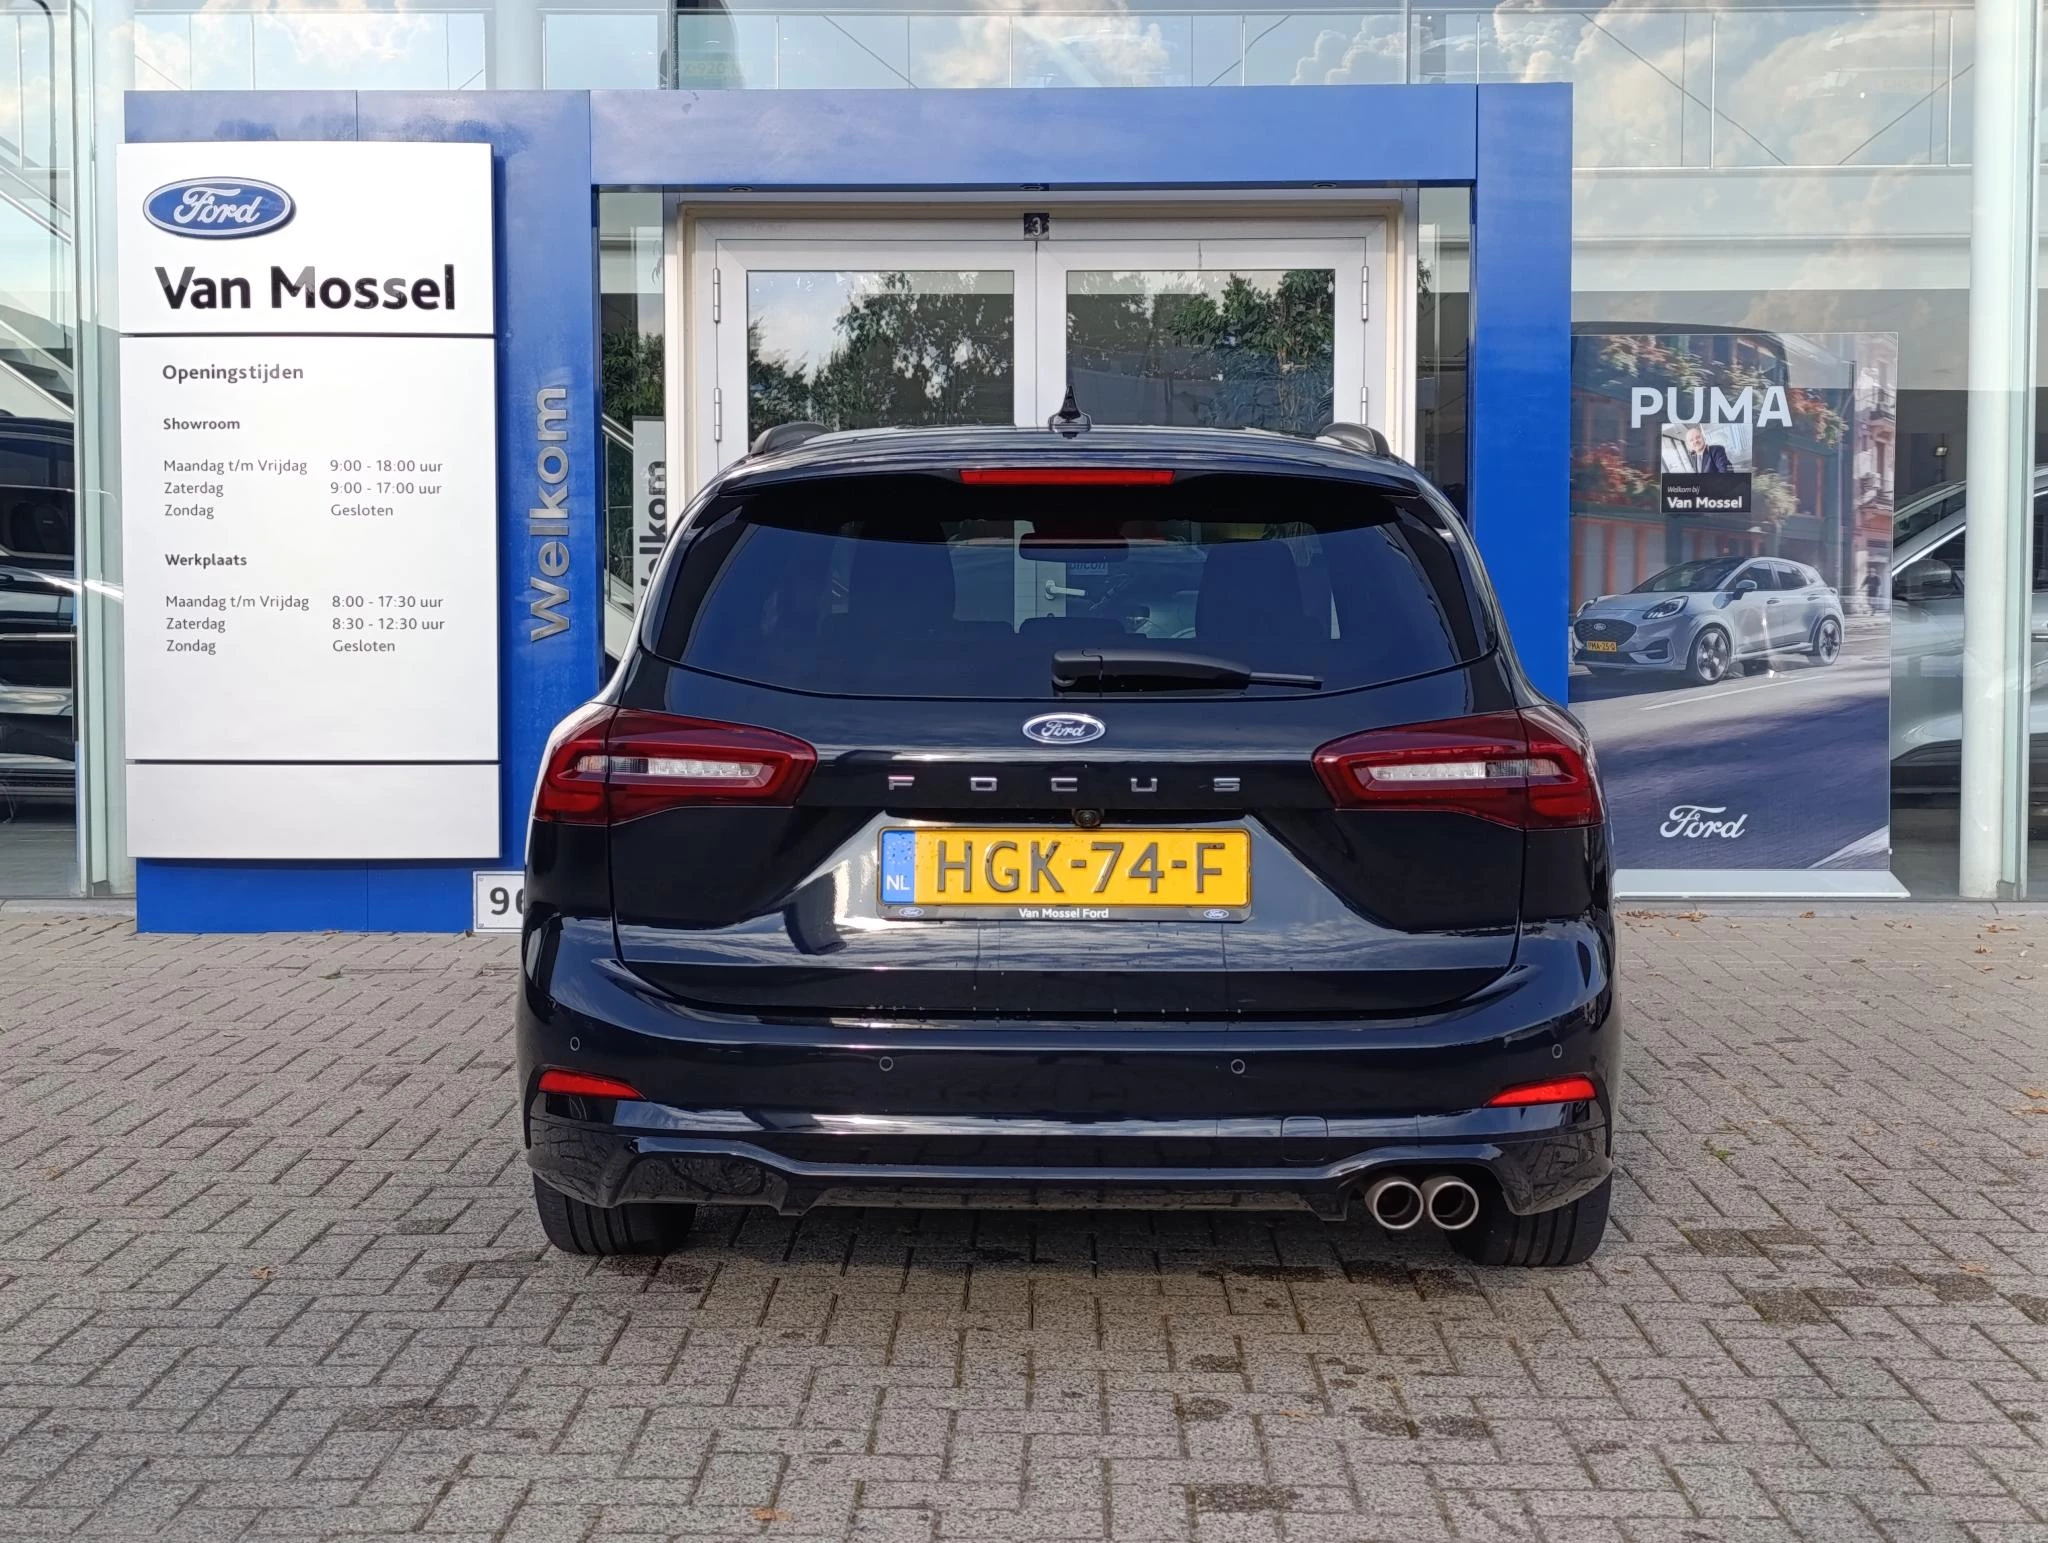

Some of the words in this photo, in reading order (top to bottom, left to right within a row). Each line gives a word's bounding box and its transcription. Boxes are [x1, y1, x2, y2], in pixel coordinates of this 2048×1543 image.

[173, 186, 263, 224] Ford
[1031, 216, 1041, 236] 3
[154, 266, 251, 310] Van
[270, 263, 456, 311] Mossel
[162, 364, 304, 385] Openingstijden
[1631, 385, 1793, 429] PUMA
[163, 418, 241, 432] Showroom
[163, 459, 225, 475] Maandag
[228, 459, 254, 472] t/m
[257, 459, 308, 476] Vrijdag
[330, 459, 362, 472] 9:00
[376, 459, 416, 472] 18:00
[419, 463, 443, 473] uur
[163, 481, 225, 498] Zaterdag
[330, 481, 362, 494] 9:00
[376, 481, 415, 495] 17:00
[418, 485, 443, 495] uur
[330, 503, 394, 517] Gesloten
[1667, 496, 1692, 509] Van
[1696, 495, 1743, 509] Mossel
[164, 503, 215, 520] Zondag
[529, 388, 570, 642] Welkom
[639, 461, 666, 600] lkom
[164, 553, 248, 570] Werkplaats
[165, 595, 227, 612] Maandag
[230, 595, 256, 608] t/m
[259, 595, 310, 612] Vrijdag
[332, 595, 364, 608] 8:00
[378, 595, 416, 608] 17:30
[420, 598, 444, 609] uur
[165, 617, 226, 634] Zaterdag
[332, 617, 364, 630] 8:30
[378, 617, 418, 630] 12:30
[421, 620, 446, 631] uur
[166, 639, 217, 656] Zondag
[332, 639, 396, 653] Gesloten
[1041, 720, 1086, 736] Ford
[888, 775, 1241, 792] FOCUS
[1660, 805, 1748, 838] Ford
[937, 840, 1226, 894] HGK-74-F
[886, 874, 911, 891] NL
[1018, 907, 1039, 918] Van
[1042, 907, 1080, 919] Mossel
[1082, 907, 1109, 919] Ford
